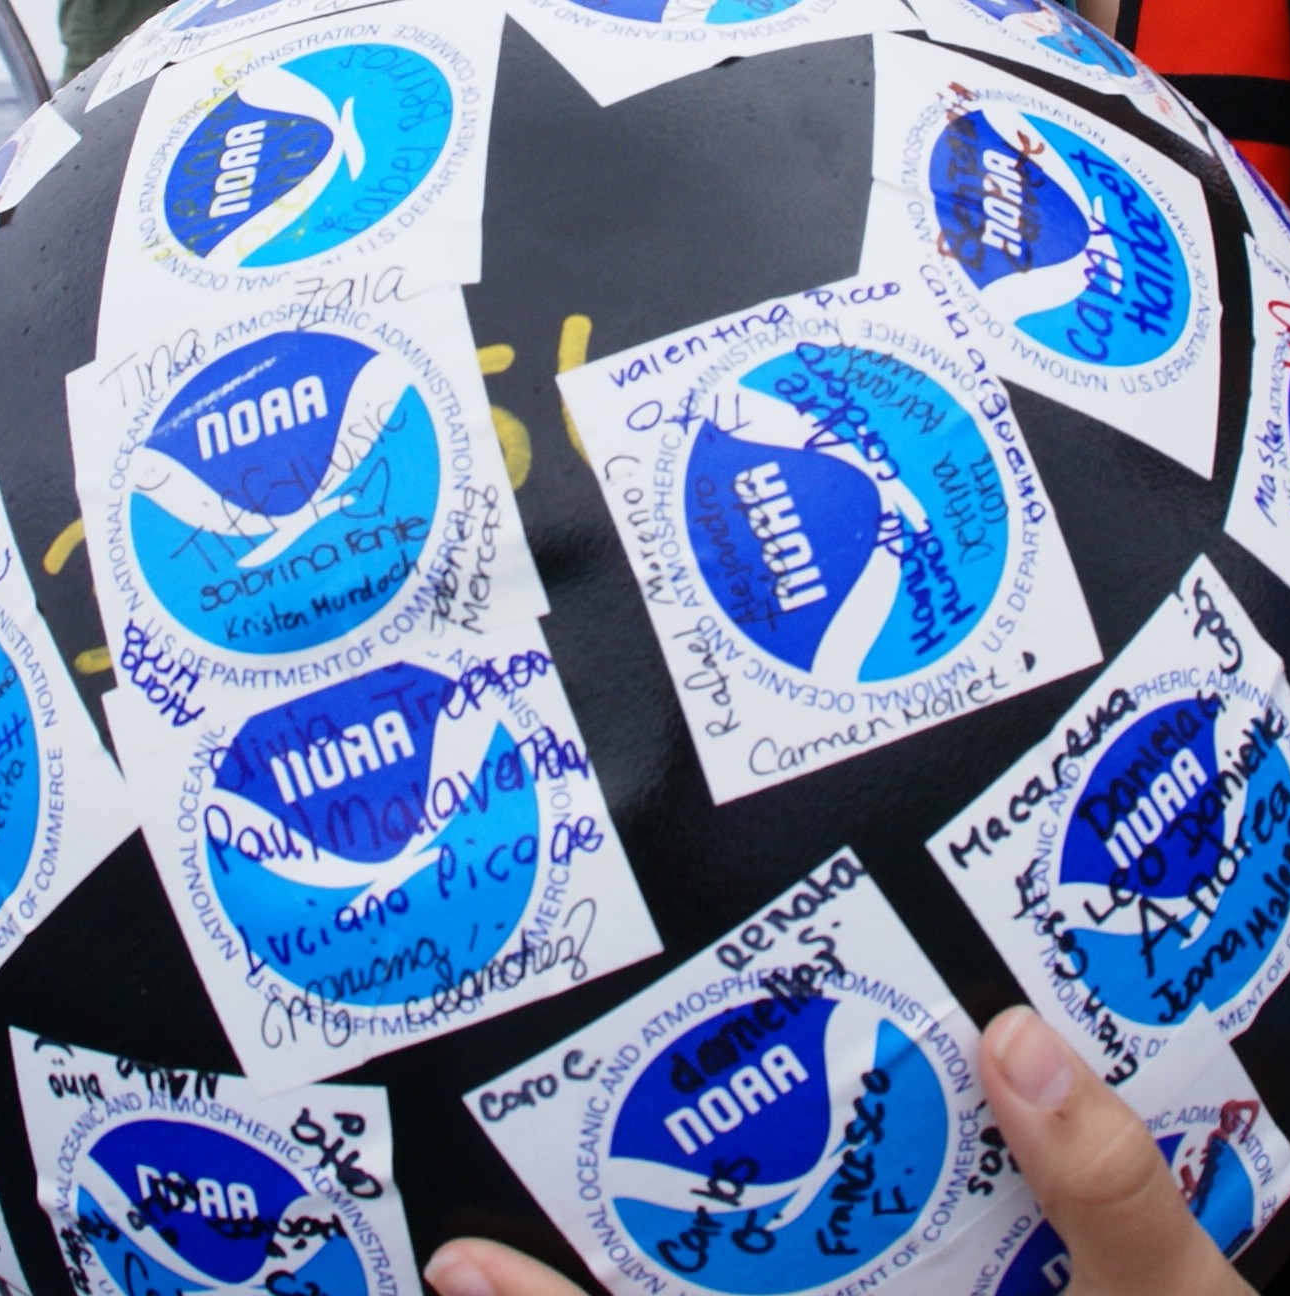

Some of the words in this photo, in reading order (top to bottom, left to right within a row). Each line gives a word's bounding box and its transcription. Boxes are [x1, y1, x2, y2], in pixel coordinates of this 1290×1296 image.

[393, 23, 477, 85] COMMERCE
[554, 5, 597, 28] AND
[603, 23, 708, 43] OCEANIC
[716, 12, 810, 42] NATIONAL
[211, 23, 382, 104] ADMINISTRATION
[463, 85, 481, 105] OF
[139, 99, 207, 214] ATMOSPHERIC
[209, 120, 266, 218] NOAA
[402, 106, 479, 229] DEPARTMENT
[907, 201, 933, 244] AND
[982, 148, 1022, 257] NOAA
[1122, 155, 1201, 261] COMMERCE
[153, 246, 228, 292] OCEANIC
[212, 301, 372, 351] ATMOSPHERIC
[859, 320, 989, 408] COMMERCE
[1011, 332, 1109, 392] NATIONAL
[1153, 293, 1211, 389] DEPARTMENT
[110, 384, 167, 496] OCEANIC
[195, 374, 329, 461] NOAA
[372, 323, 474, 493] ADMINISTRATION
[108, 496, 144, 613] NATIONAL
[652, 431, 704, 610] ATMOSPHERIC
[734, 461, 828, 613] NOAA
[177, 646, 353, 691] DEPARTMENT
[347, 639, 375, 670] OF
[383, 504, 471, 647] COMMERCE
[223, 599, 309, 644] Kristen
[695, 611, 745, 659] AND
[982, 615, 1015, 656] U.S.
[743, 657, 856, 716] OCEANIC
[861, 655, 977, 715] NATIONAL
[178, 723, 227, 834] OCEANIC
[270, 708, 416, 805] NOAA
[747, 713, 895, 777] Carmen
[947, 685, 1143, 871] Macarena
[18, 893, 39, 921] OF
[34, 747, 63, 893] COMMERCE
[203, 795, 321, 874] Paul
[1105, 746, 1210, 869] NOAA
[180, 848, 240, 962] NATIONAL
[1264, 950, 1286, 983] OF
[602, 1042, 643, 1096] AND
[823, 966, 973, 1095] ADMINISTRATION
[57, 1105, 105, 1176] OCEANIC
[104, 1090, 143, 1117] AND
[147, 1091, 307, 1168] ATMOSPHERIC
[663, 1043, 810, 1157] NOAA
[136, 1163, 260, 1220] NOAA
[575, 1095, 611, 1204] OCEANIC
[891, 1237, 924, 1271] OF
[921, 1104, 981, 1244] COMMERCE
[586, 1202, 667, 1296] NATIONAL
[994, 1214, 1034, 1260] AND
